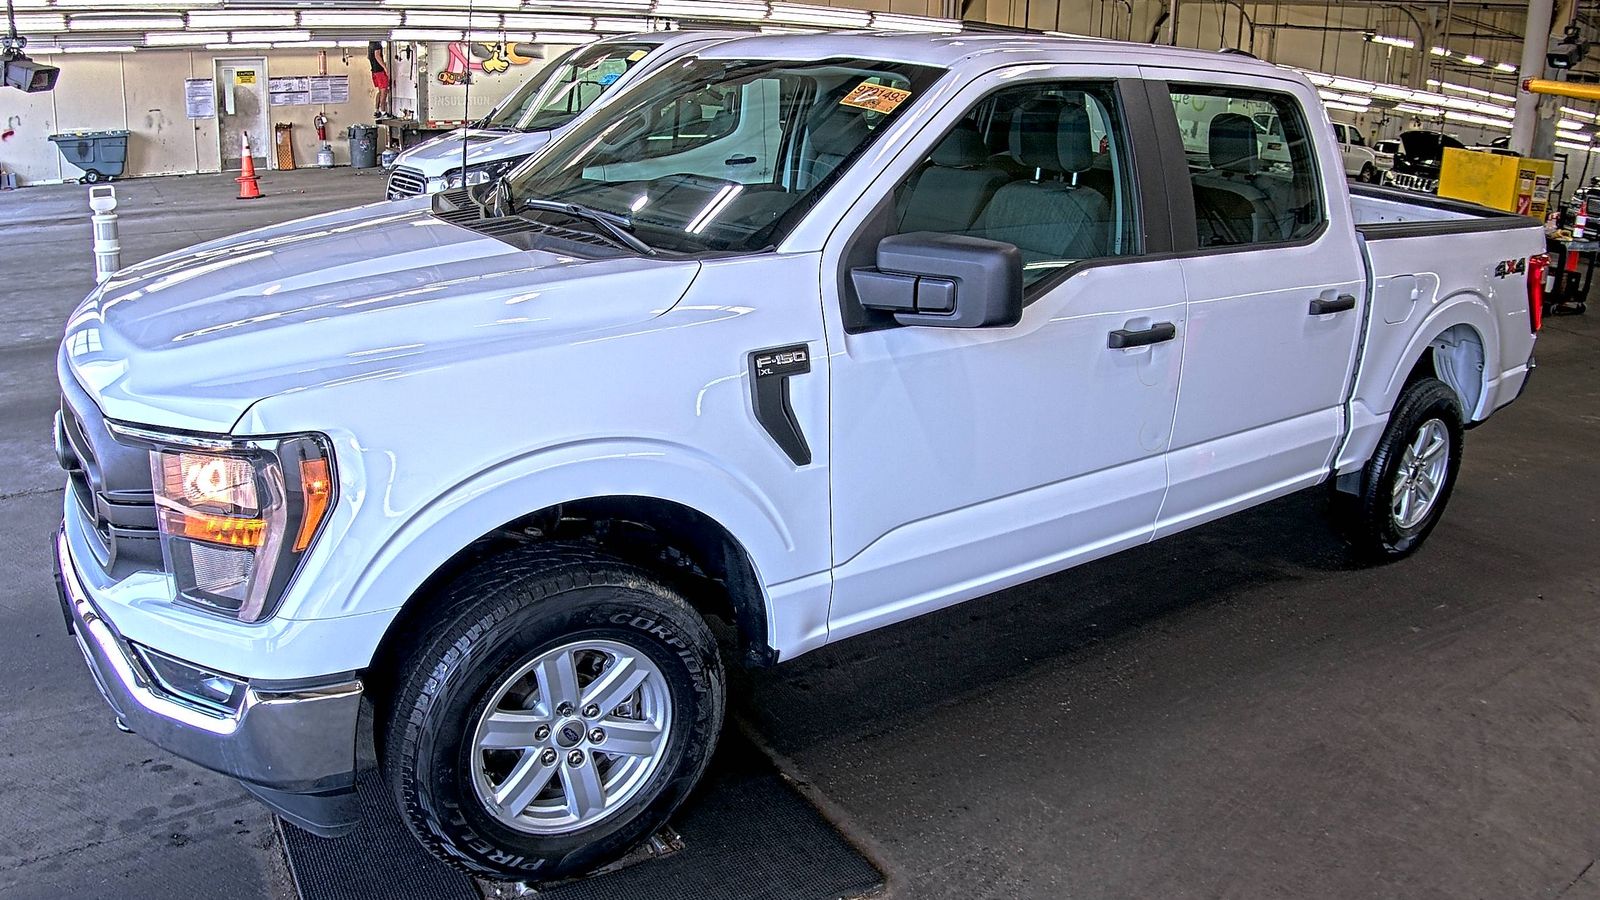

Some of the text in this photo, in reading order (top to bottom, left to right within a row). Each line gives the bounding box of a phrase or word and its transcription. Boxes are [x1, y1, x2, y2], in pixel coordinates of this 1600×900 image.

[434, 95, 490, 106] INSULTION
[756, 351, 807, 368] F-150
[760, 368, 774, 376] XL
[600, 612, 707, 692] CORPION
[443, 801, 545, 870] PIRELLI
